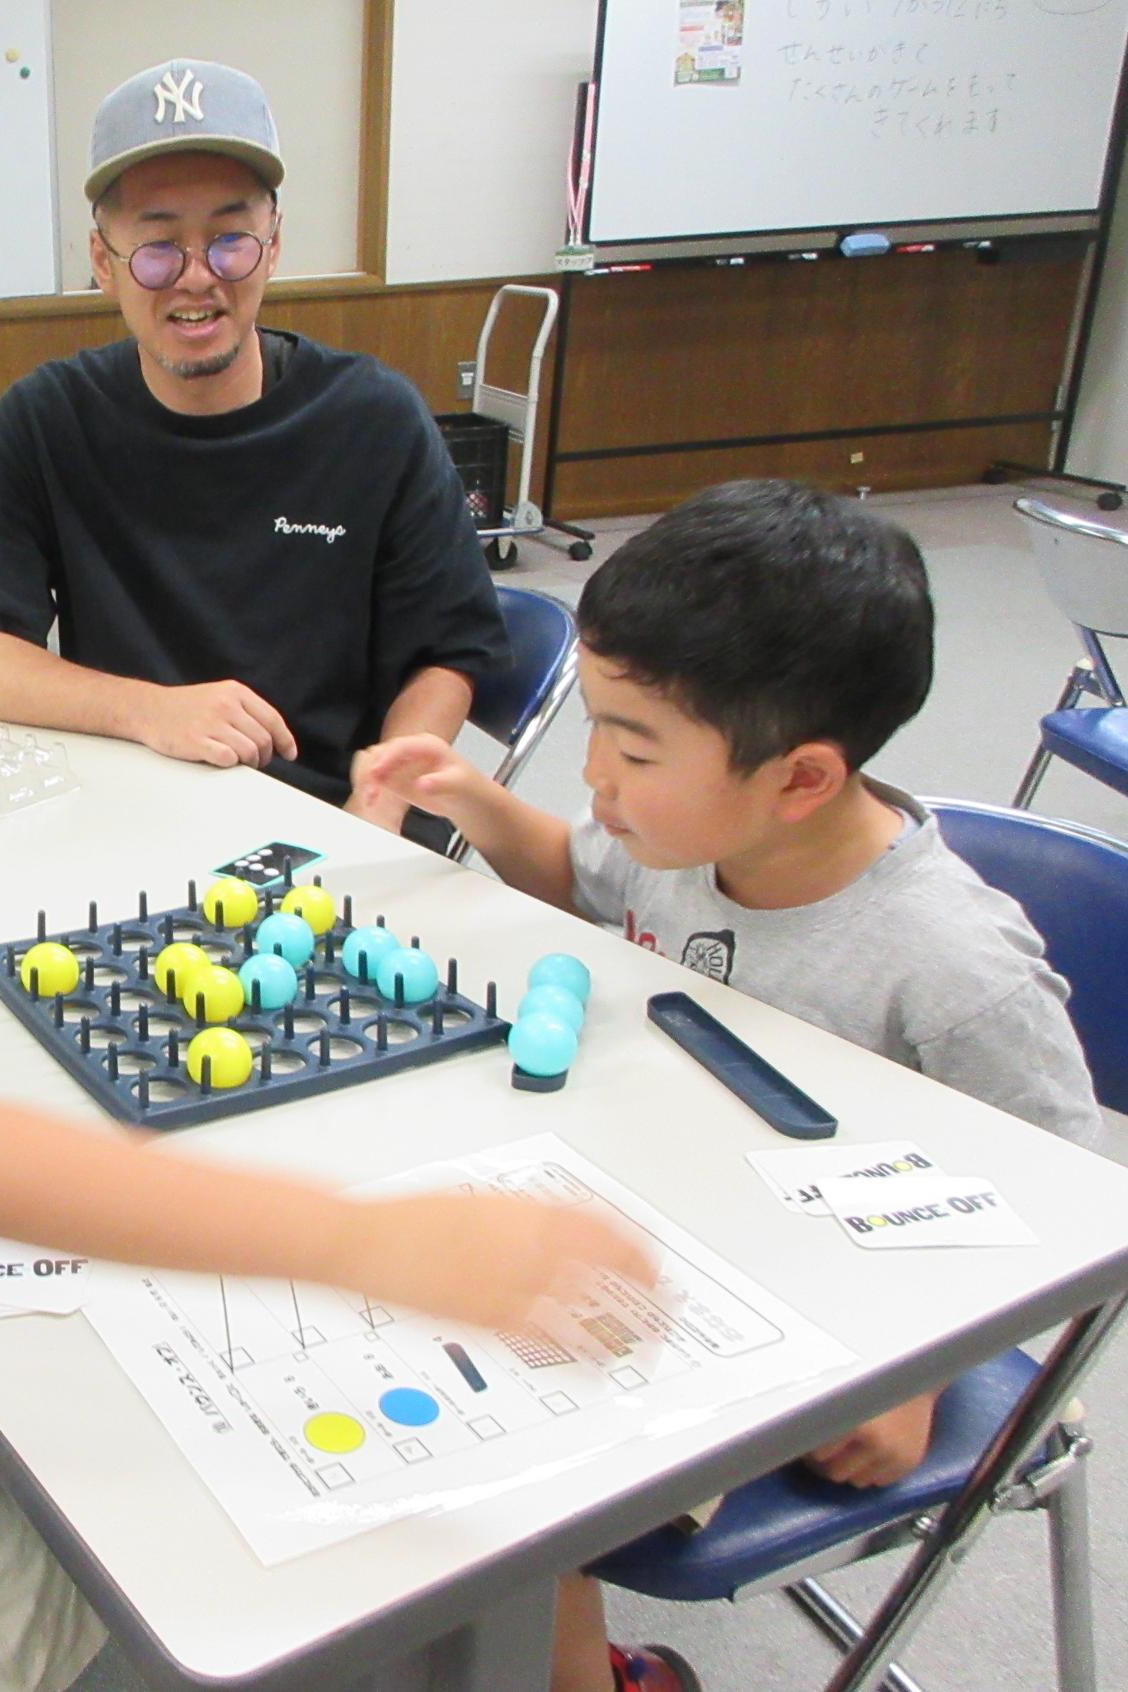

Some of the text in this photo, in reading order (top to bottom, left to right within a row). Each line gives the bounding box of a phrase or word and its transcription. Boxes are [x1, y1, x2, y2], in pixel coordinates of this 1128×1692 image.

[153, 68, 204, 123] NY
[273, 516, 346, 544] Penneys
[845, 1191, 998, 1234] BOUNCE OFF
[33, 1258, 89, 1277] OFF
